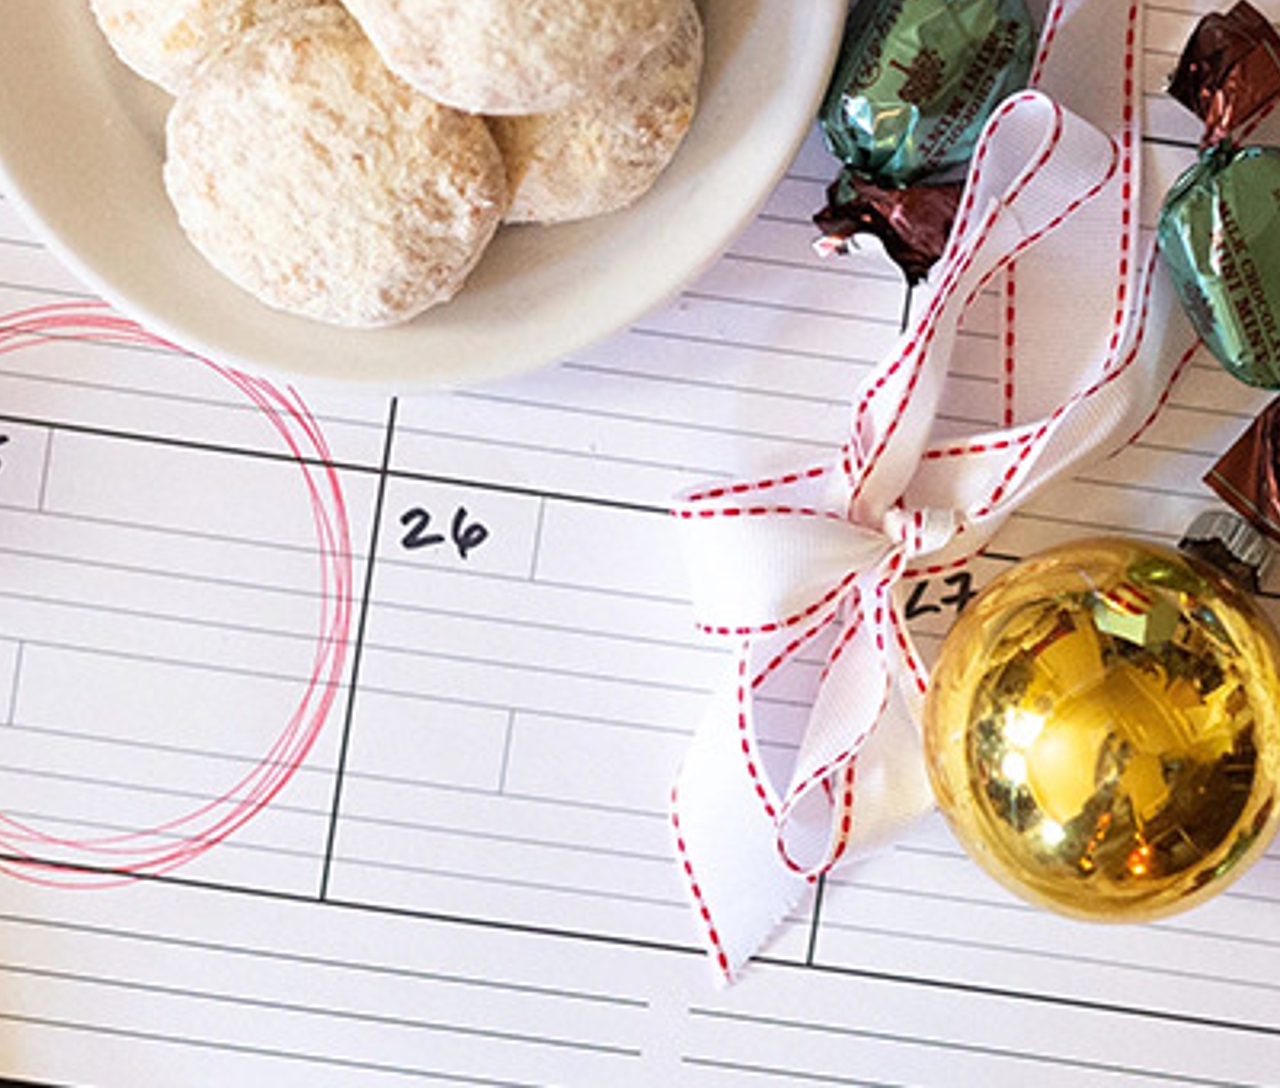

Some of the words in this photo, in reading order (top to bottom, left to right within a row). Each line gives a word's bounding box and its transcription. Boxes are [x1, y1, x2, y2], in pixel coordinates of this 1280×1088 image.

[1219, 199, 1248, 257] MILK
[1233, 295, 1270, 363] MINT
[399, 505, 490, 559] 26
